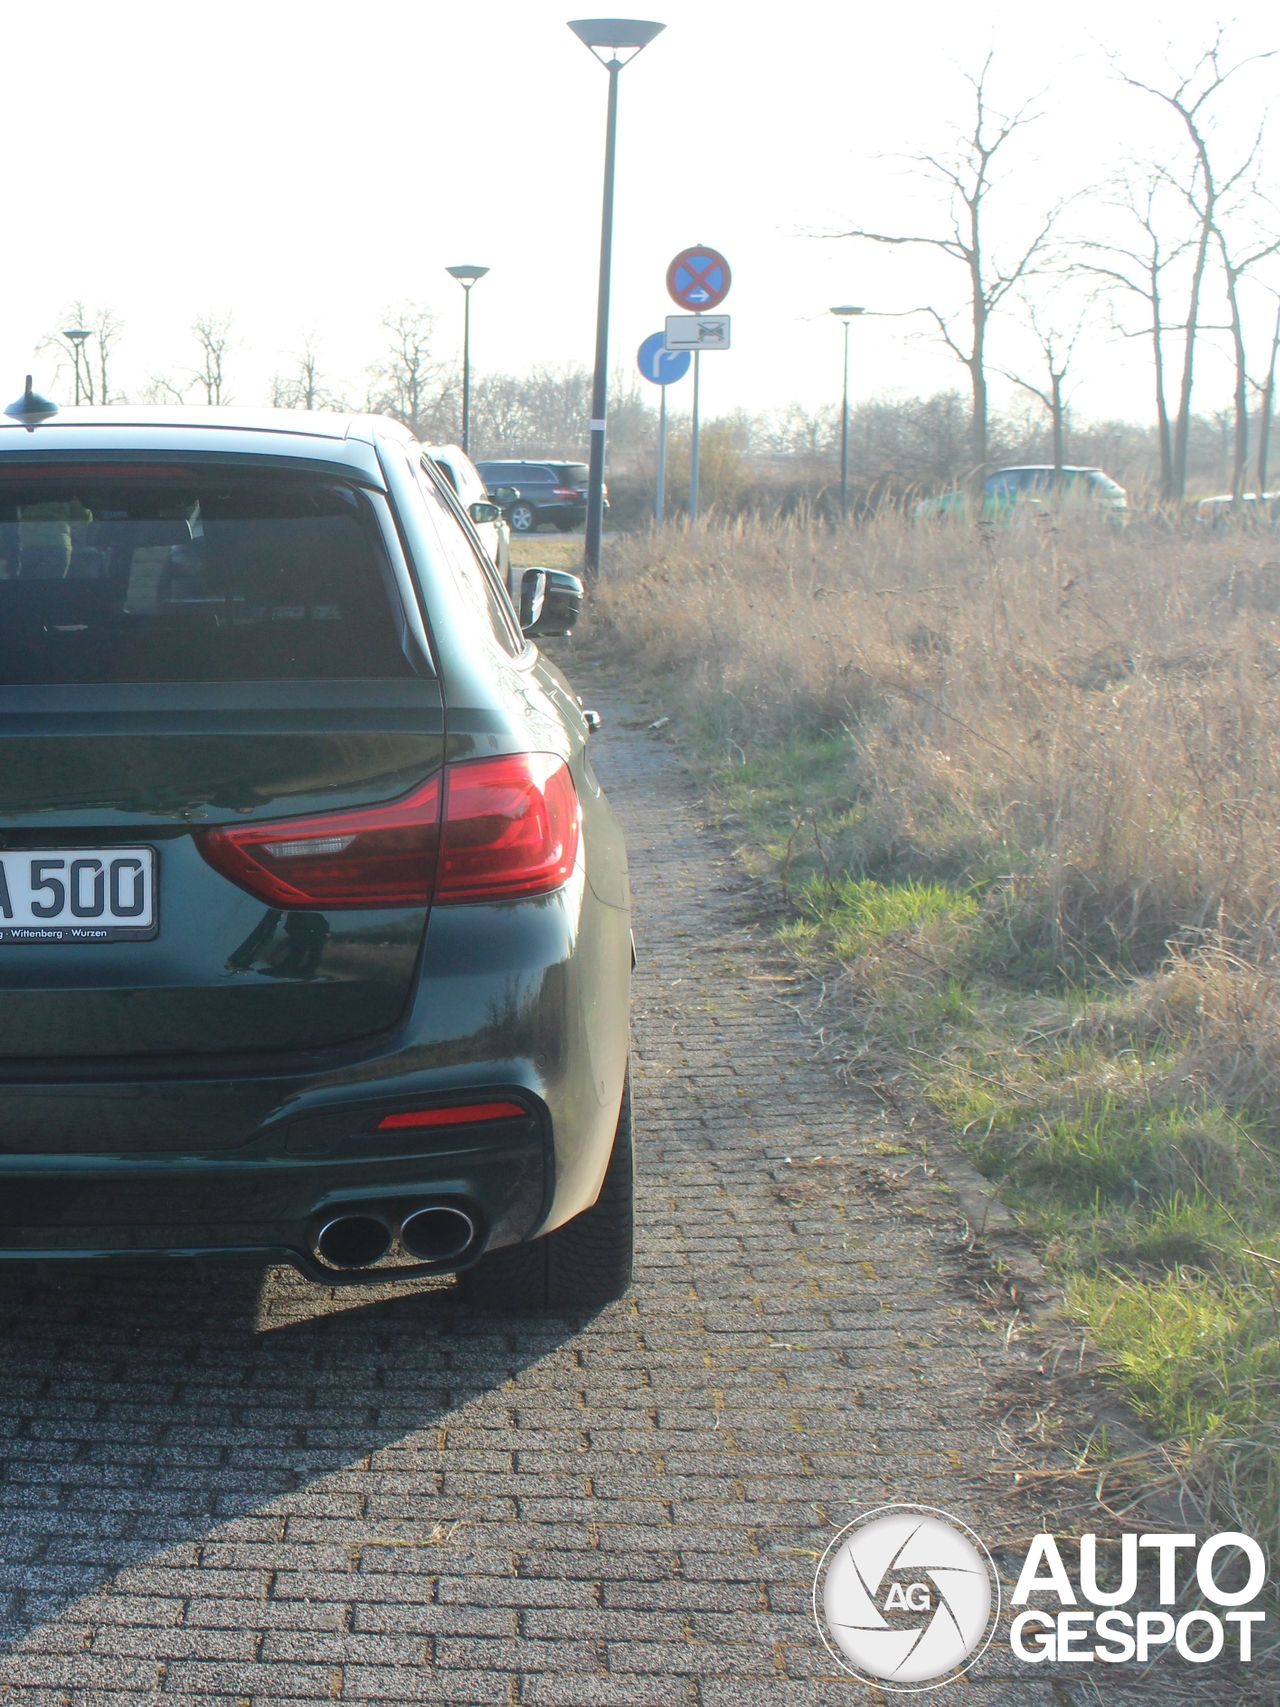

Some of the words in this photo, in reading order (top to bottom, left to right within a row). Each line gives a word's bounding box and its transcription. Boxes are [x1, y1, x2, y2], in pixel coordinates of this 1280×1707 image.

[30, 858, 145, 918] 500
[11, 929, 63, 939] Wittenberg
[71, 928, 107, 938] Wurzen
